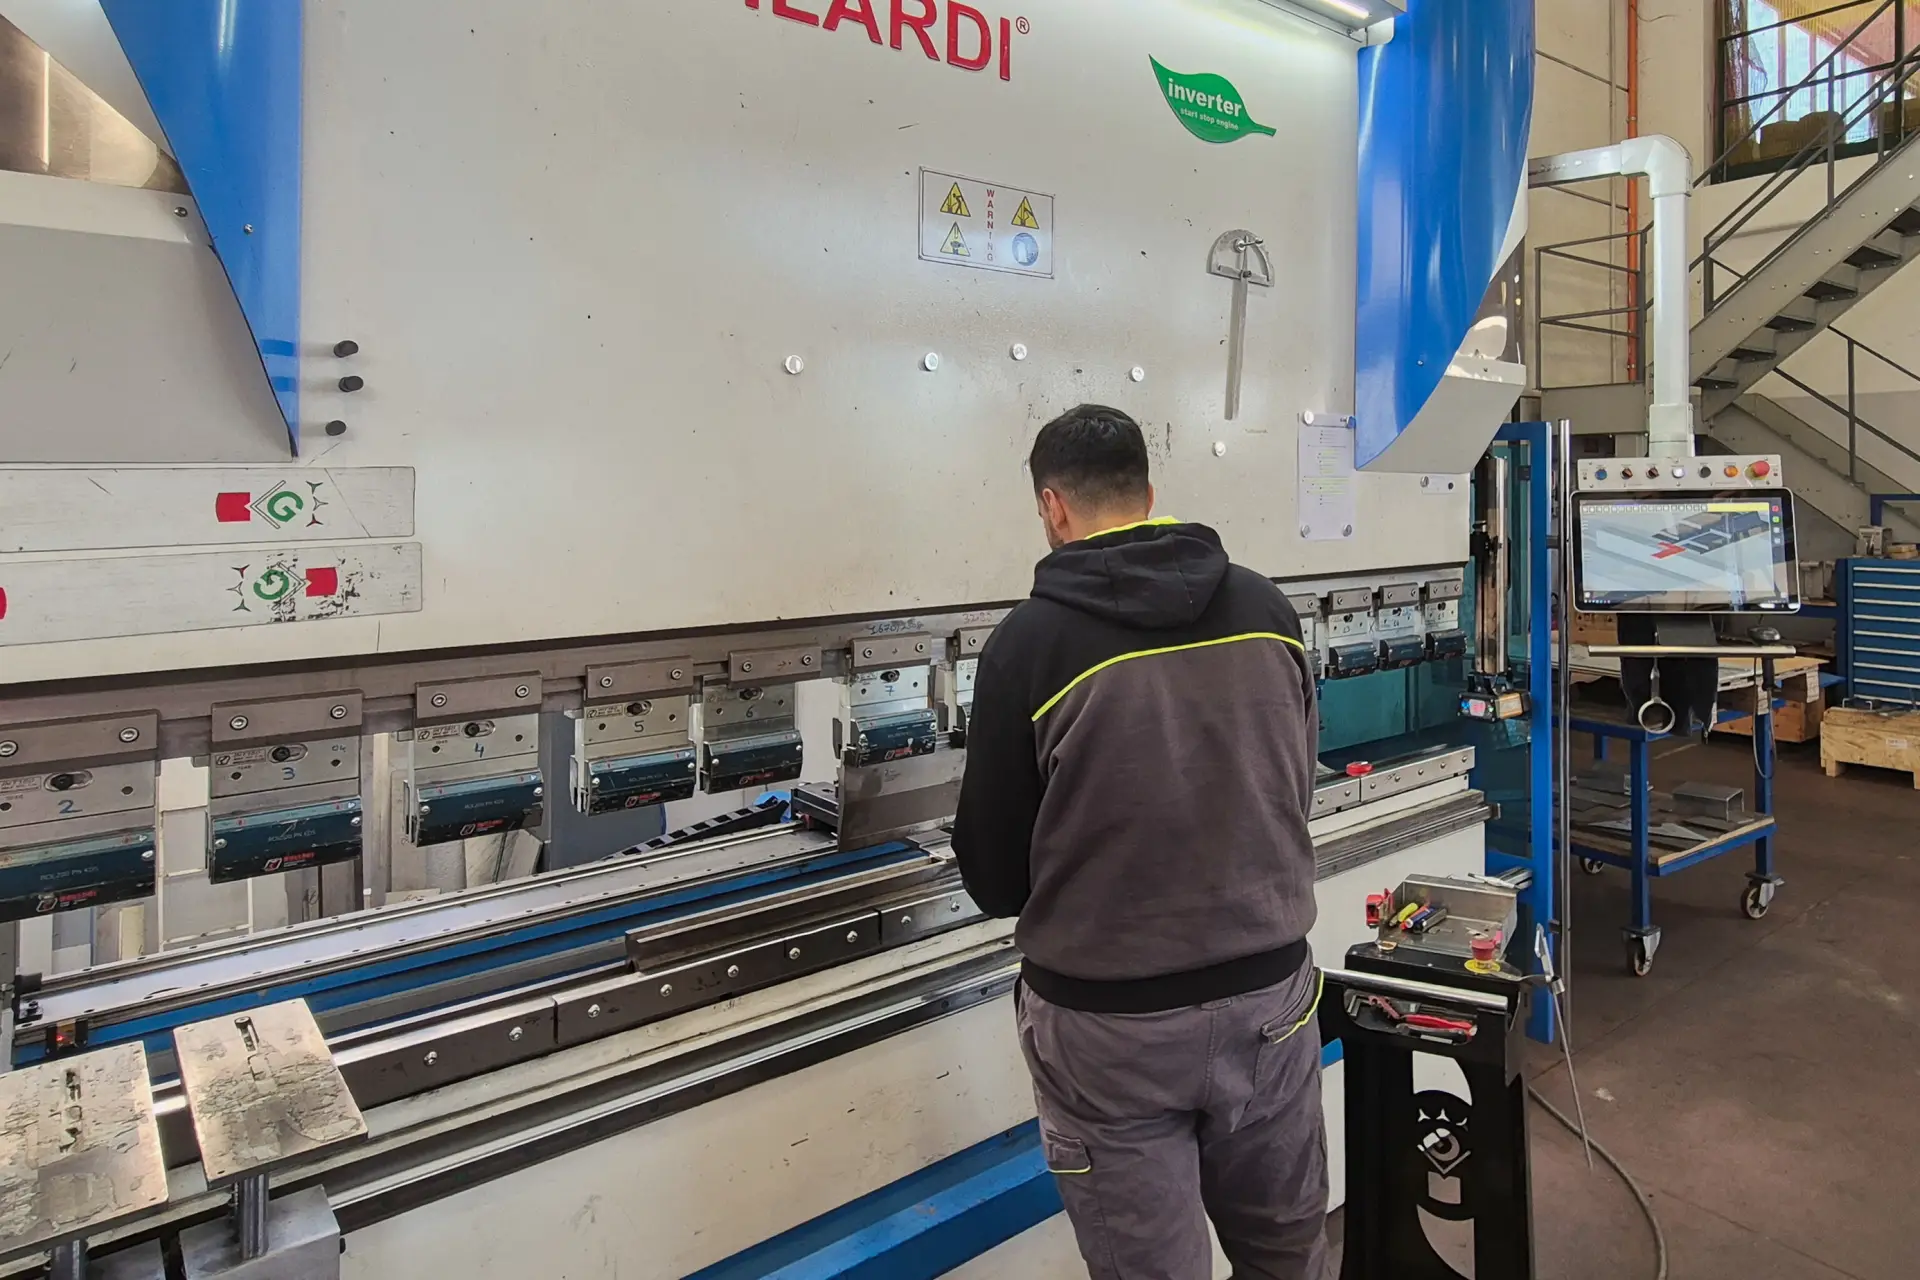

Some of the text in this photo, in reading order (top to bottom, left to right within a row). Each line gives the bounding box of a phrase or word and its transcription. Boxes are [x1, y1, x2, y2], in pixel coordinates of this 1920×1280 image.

[1168, 78, 1242, 117] inverter
[1179, 107, 1239, 130] start stop engine
[986, 189, 995, 261] WARNING
[885, 685, 895, 696] 7
[746, 705, 755, 718] 6
[634, 720, 645, 733] 5
[475, 742, 485, 758] 4
[282, 766, 295, 781] 3
[57, 799, 83, 814] 2
